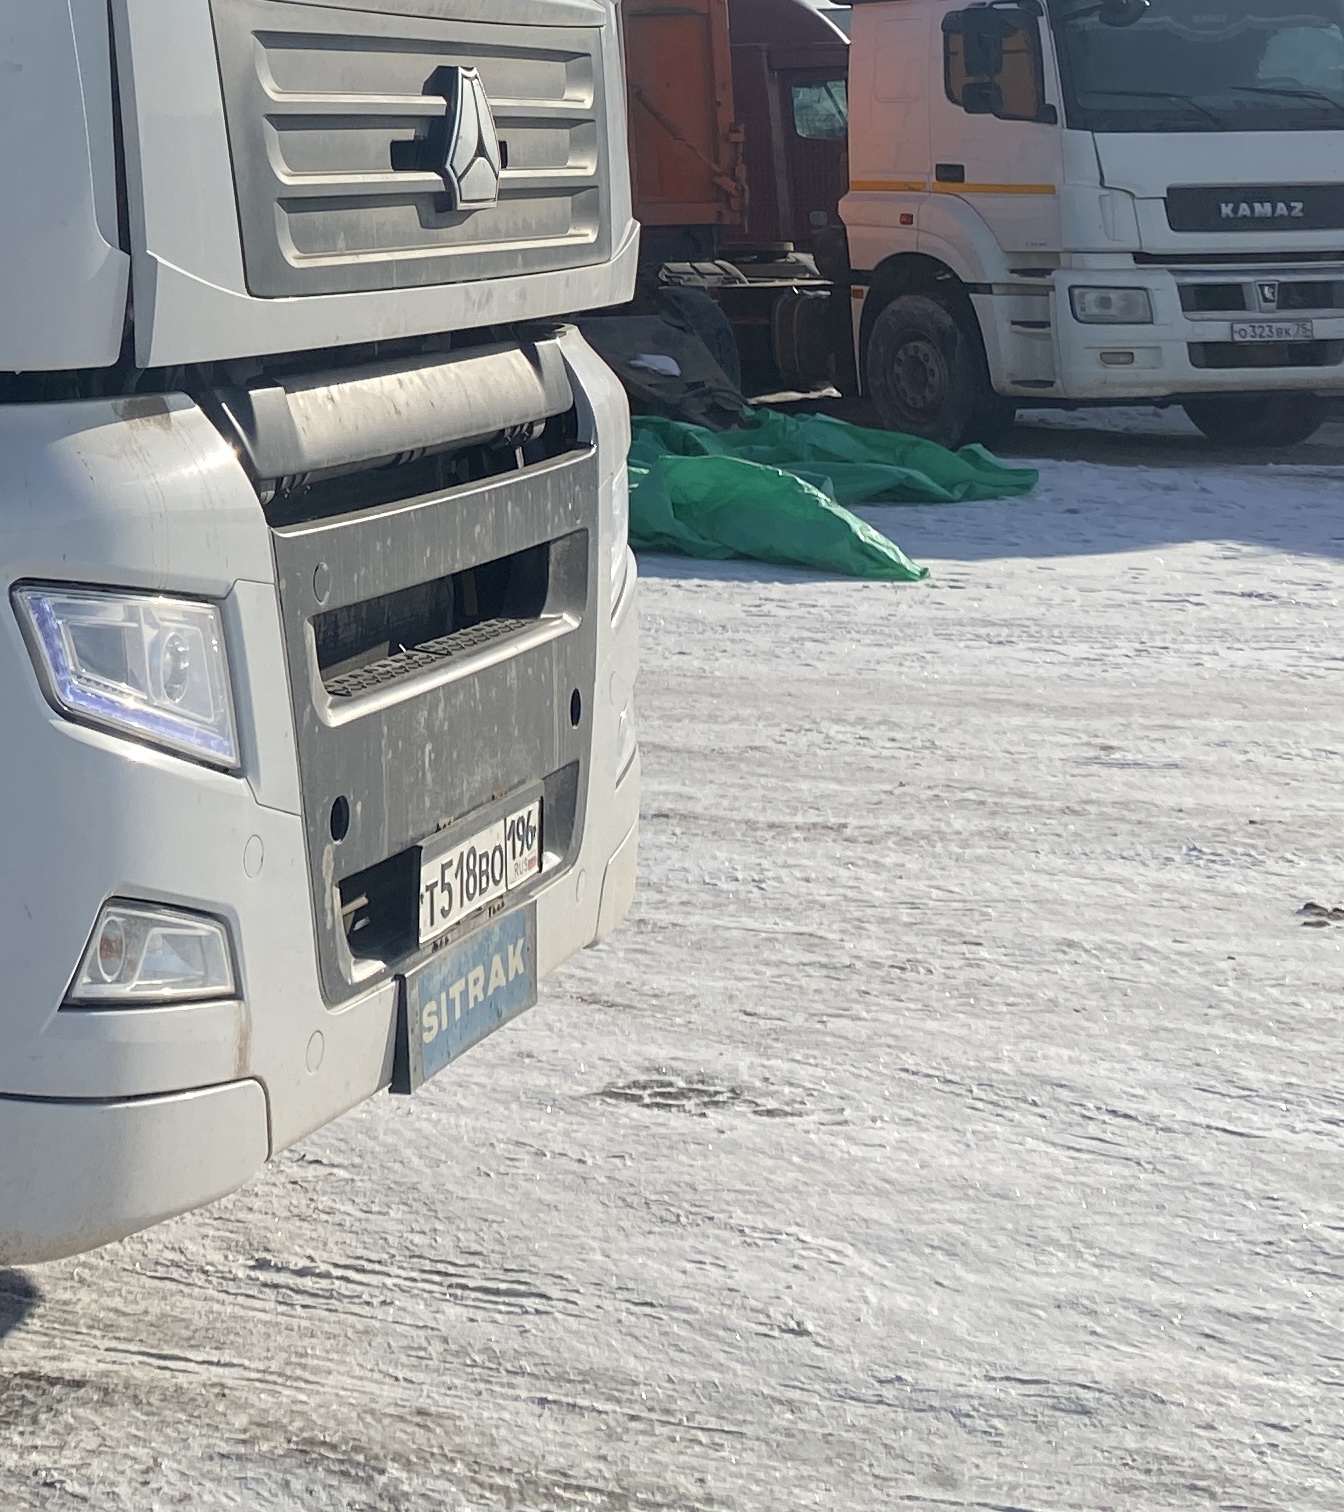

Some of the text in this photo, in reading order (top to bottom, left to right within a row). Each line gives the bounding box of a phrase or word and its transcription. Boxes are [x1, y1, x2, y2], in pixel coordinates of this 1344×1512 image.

[1220, 201, 1304, 218] KAMAZ
[507, 809, 535, 862] 196
[422, 938, 526, 1044] SITRAK
